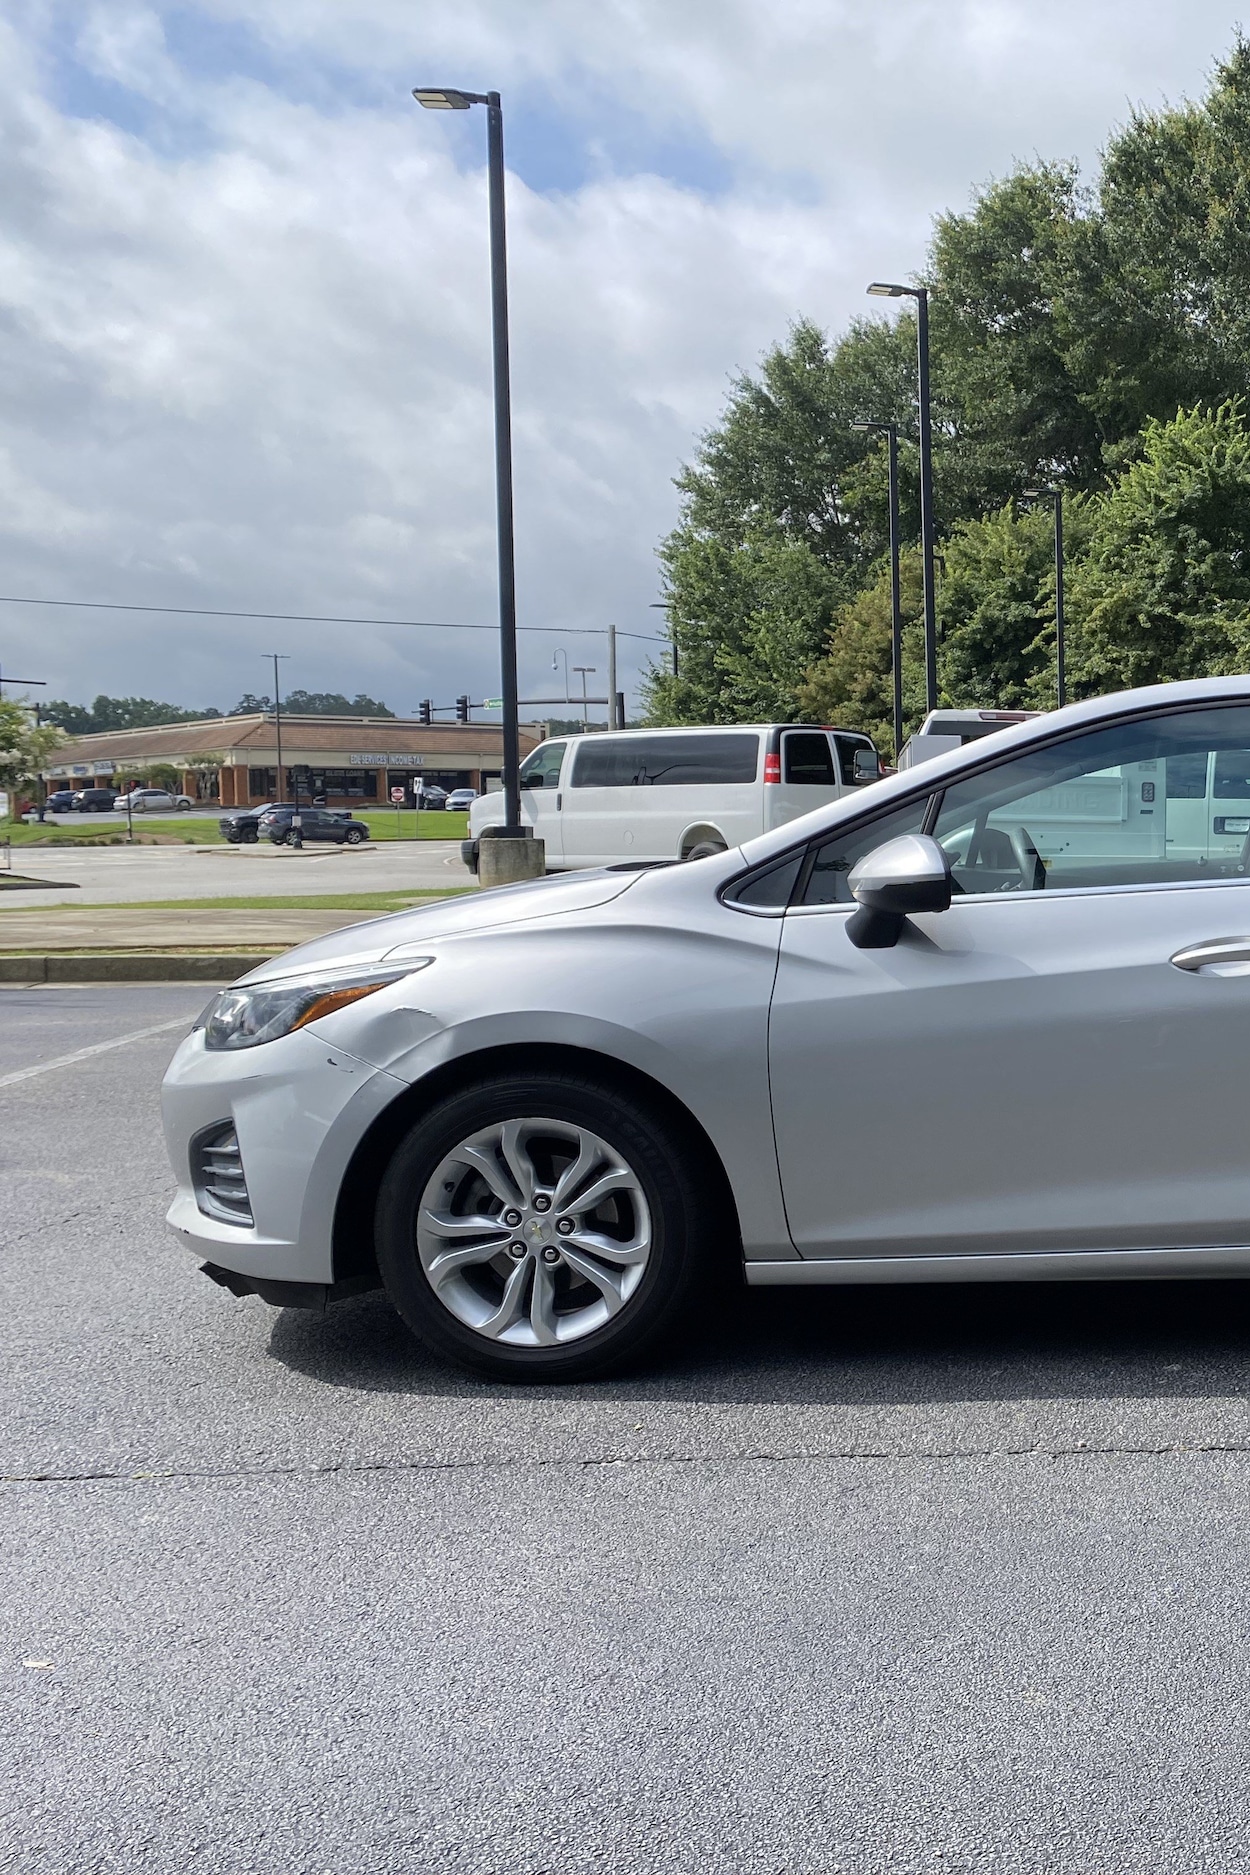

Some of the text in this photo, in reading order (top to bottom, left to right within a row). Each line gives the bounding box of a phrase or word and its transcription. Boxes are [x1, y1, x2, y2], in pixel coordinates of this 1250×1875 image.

[362, 754, 387, 765] SERVICES
[389, 755, 412, 765] INCOME
[412, 755, 424, 766] TAX
